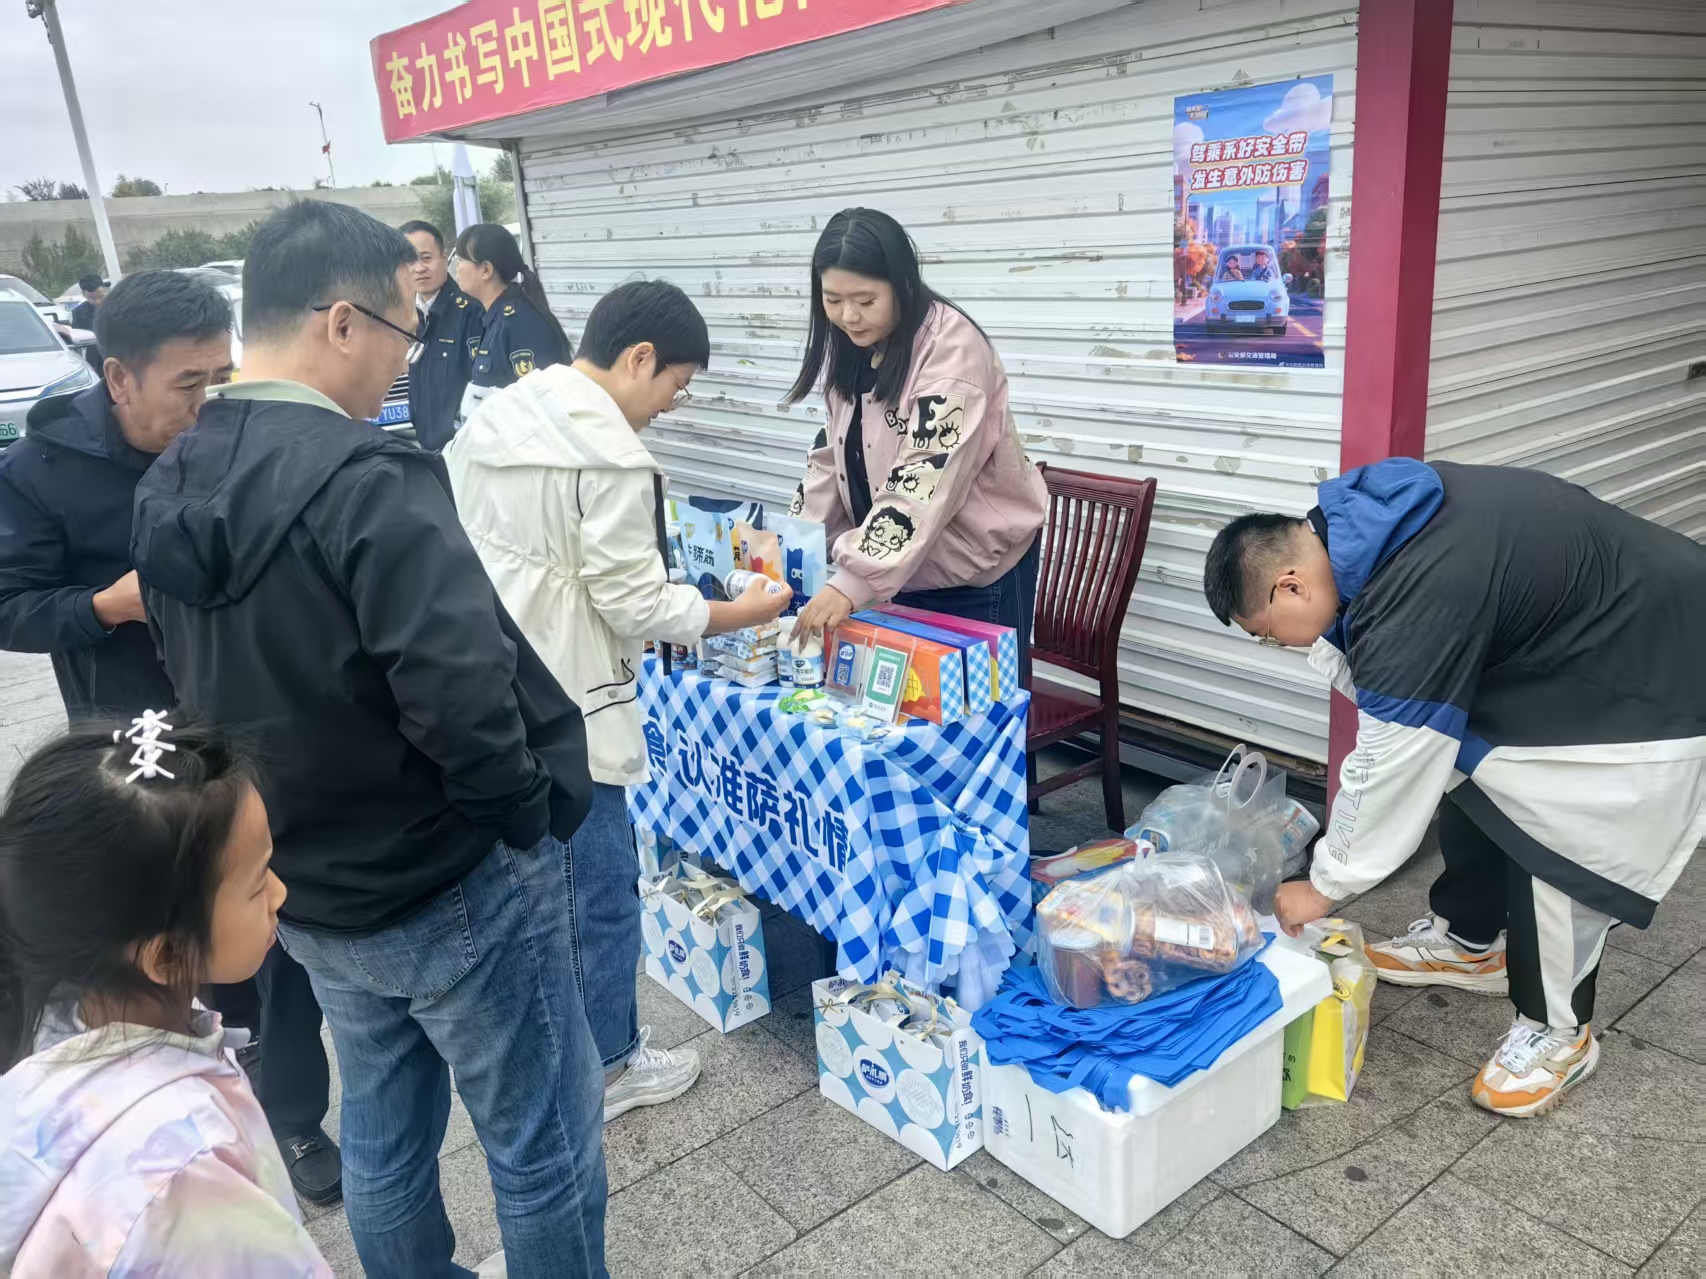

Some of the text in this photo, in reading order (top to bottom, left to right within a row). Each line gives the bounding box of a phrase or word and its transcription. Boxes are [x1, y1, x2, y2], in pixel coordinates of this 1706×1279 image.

[385, 0, 808, 119] 奋力书写中国式现代
[1191, 132, 1307, 163] 驾乘系好安全带
[1191, 160, 1307, 190] 发生意外防伤害
[373, 405, 409, 422] YU38
